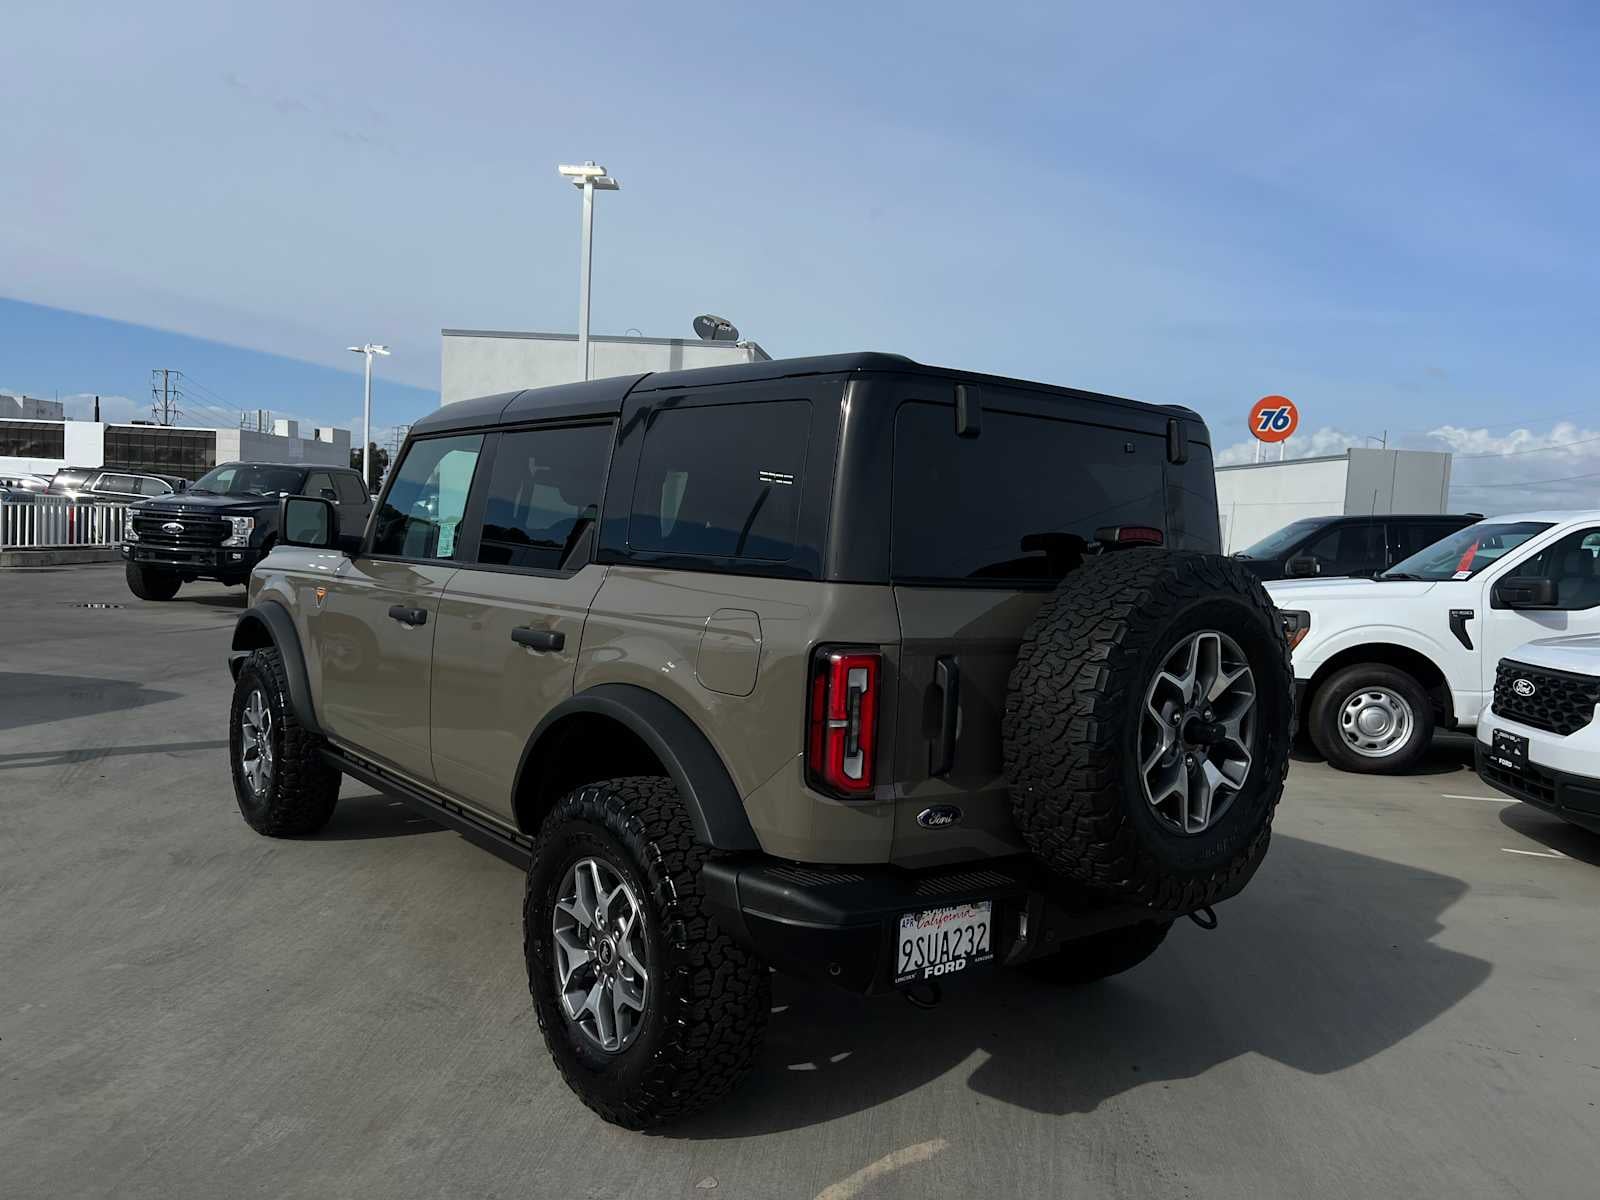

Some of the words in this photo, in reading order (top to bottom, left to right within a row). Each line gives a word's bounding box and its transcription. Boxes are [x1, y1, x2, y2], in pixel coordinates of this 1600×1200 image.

[1257, 406, 1292, 432] 76
[928, 812, 953, 825] Ford
[917, 909, 977, 930] California
[902, 922, 988, 976] 9SUA232
[924, 958, 967, 979] FORD
